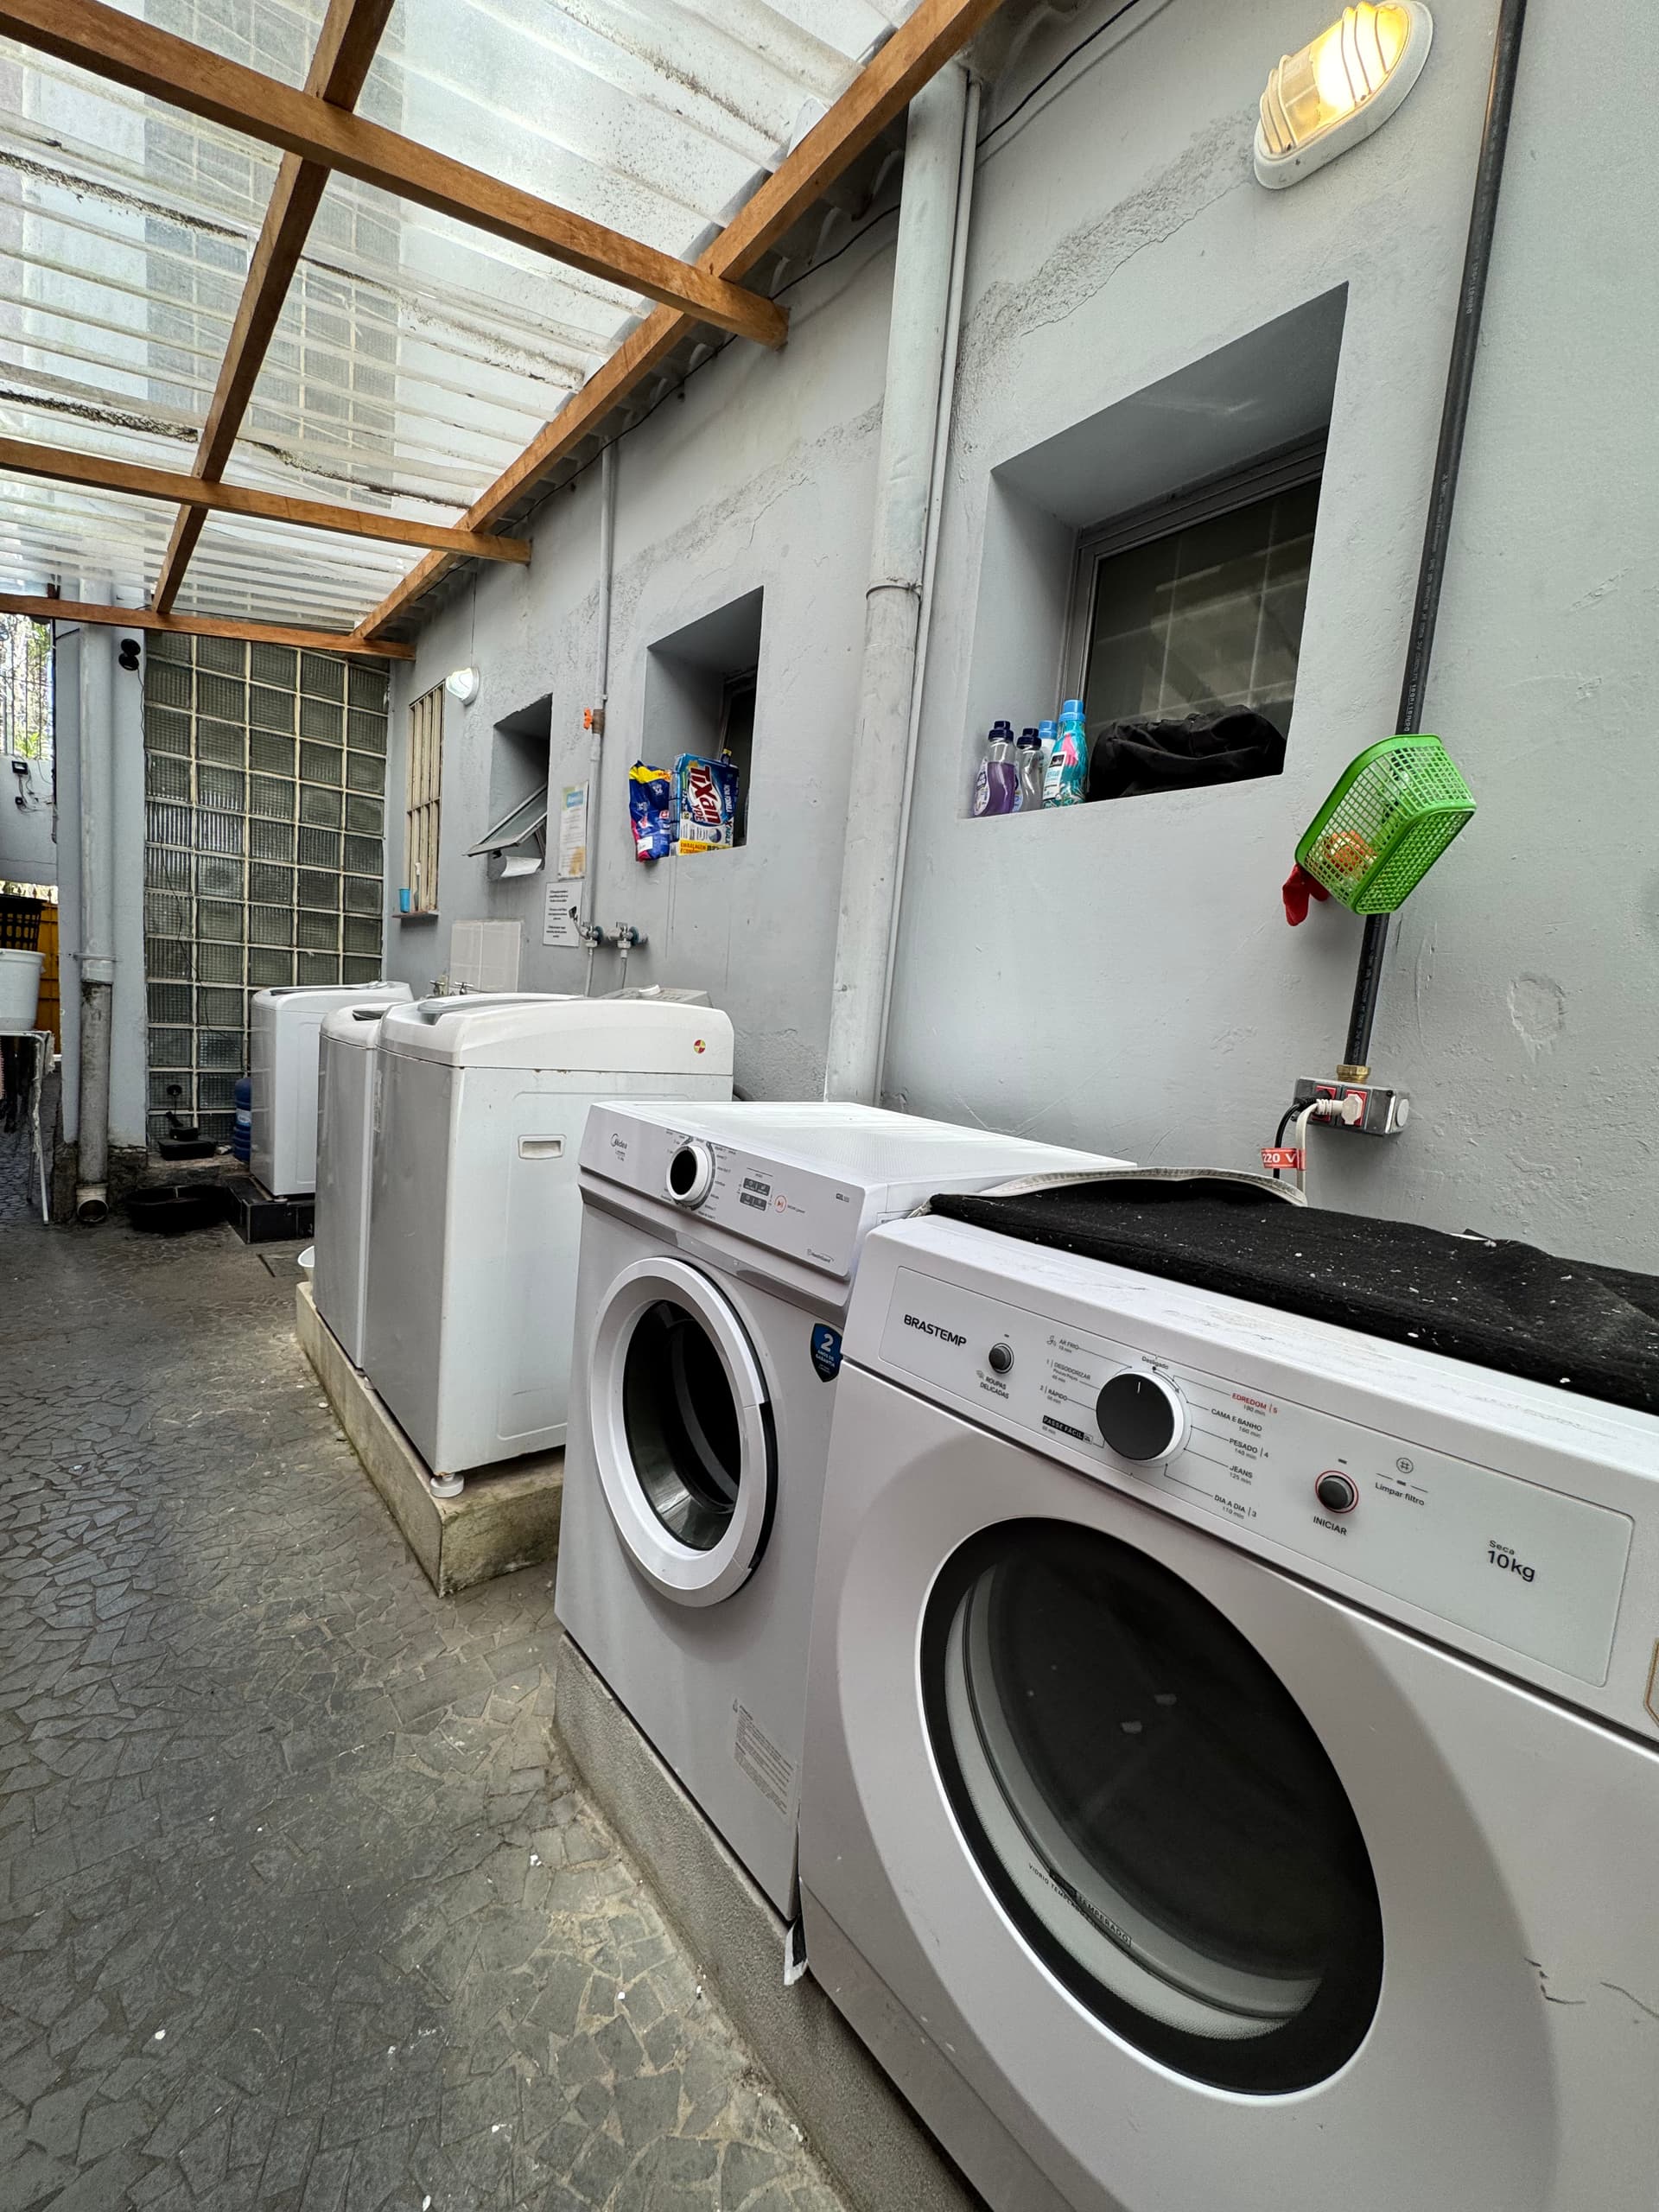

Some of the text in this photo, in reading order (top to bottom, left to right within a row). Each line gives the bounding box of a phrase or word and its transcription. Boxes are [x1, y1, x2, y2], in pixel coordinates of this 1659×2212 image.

[1285, 1153, 1297, 1163] V
[904, 1313, 967, 1346] BRASTEMP
[820, 1333, 834, 1352] 2
[1054, 1362, 1090, 1380] DESODORIZAR
[1141, 1356, 1169, 1370] Desligado
[980, 1382, 1009, 1400] DELICADAS
[986, 1376, 1007, 1390] ROUPAS
[1231, 1392, 1268, 1410] EDREDOM
[1211, 1408, 1231, 1421] CAMA
[1237, 1418, 1262, 1432] BANHO
[1230, 1438, 1258, 1453] PESADO
[1229, 1465, 1254, 1479] JEANS
[1375, 1482, 1425, 1506] Limpar filtro
[1214, 1494, 1226, 1505] DIA
[1233, 1503, 1246, 1514] DIA
[1313, 1516, 1348, 1536] INICIAR
[1489, 1540, 1516, 1556] Seca
